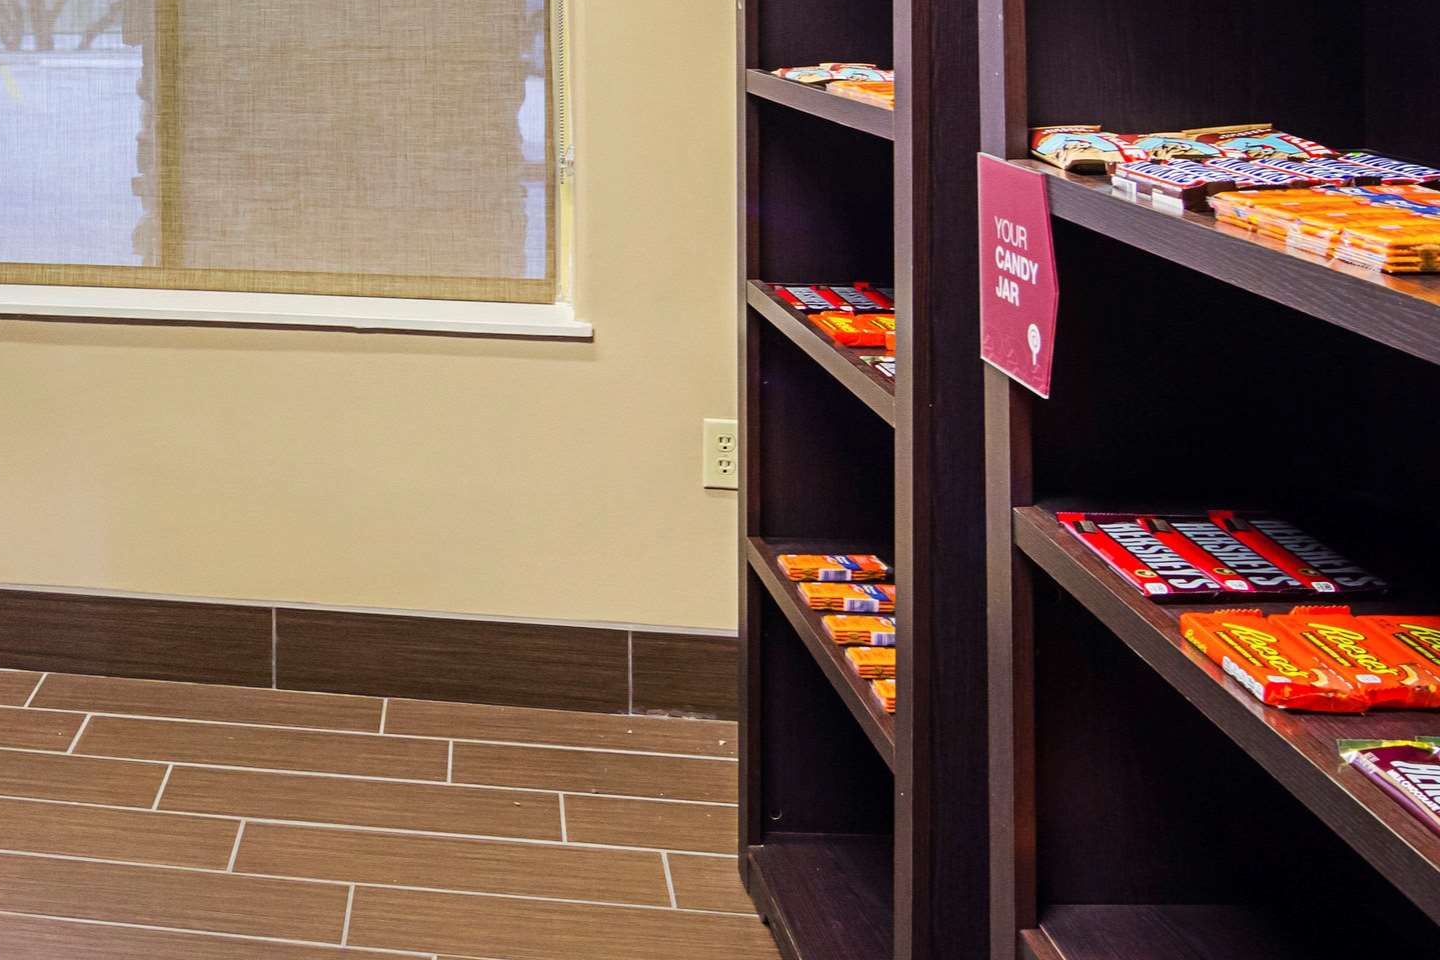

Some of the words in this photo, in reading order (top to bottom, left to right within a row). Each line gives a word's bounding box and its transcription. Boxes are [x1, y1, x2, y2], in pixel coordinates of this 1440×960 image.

[994, 216, 1028, 250] YOUR
[995, 246, 1039, 285] CANDY
[995, 276, 1020, 307] JAR
